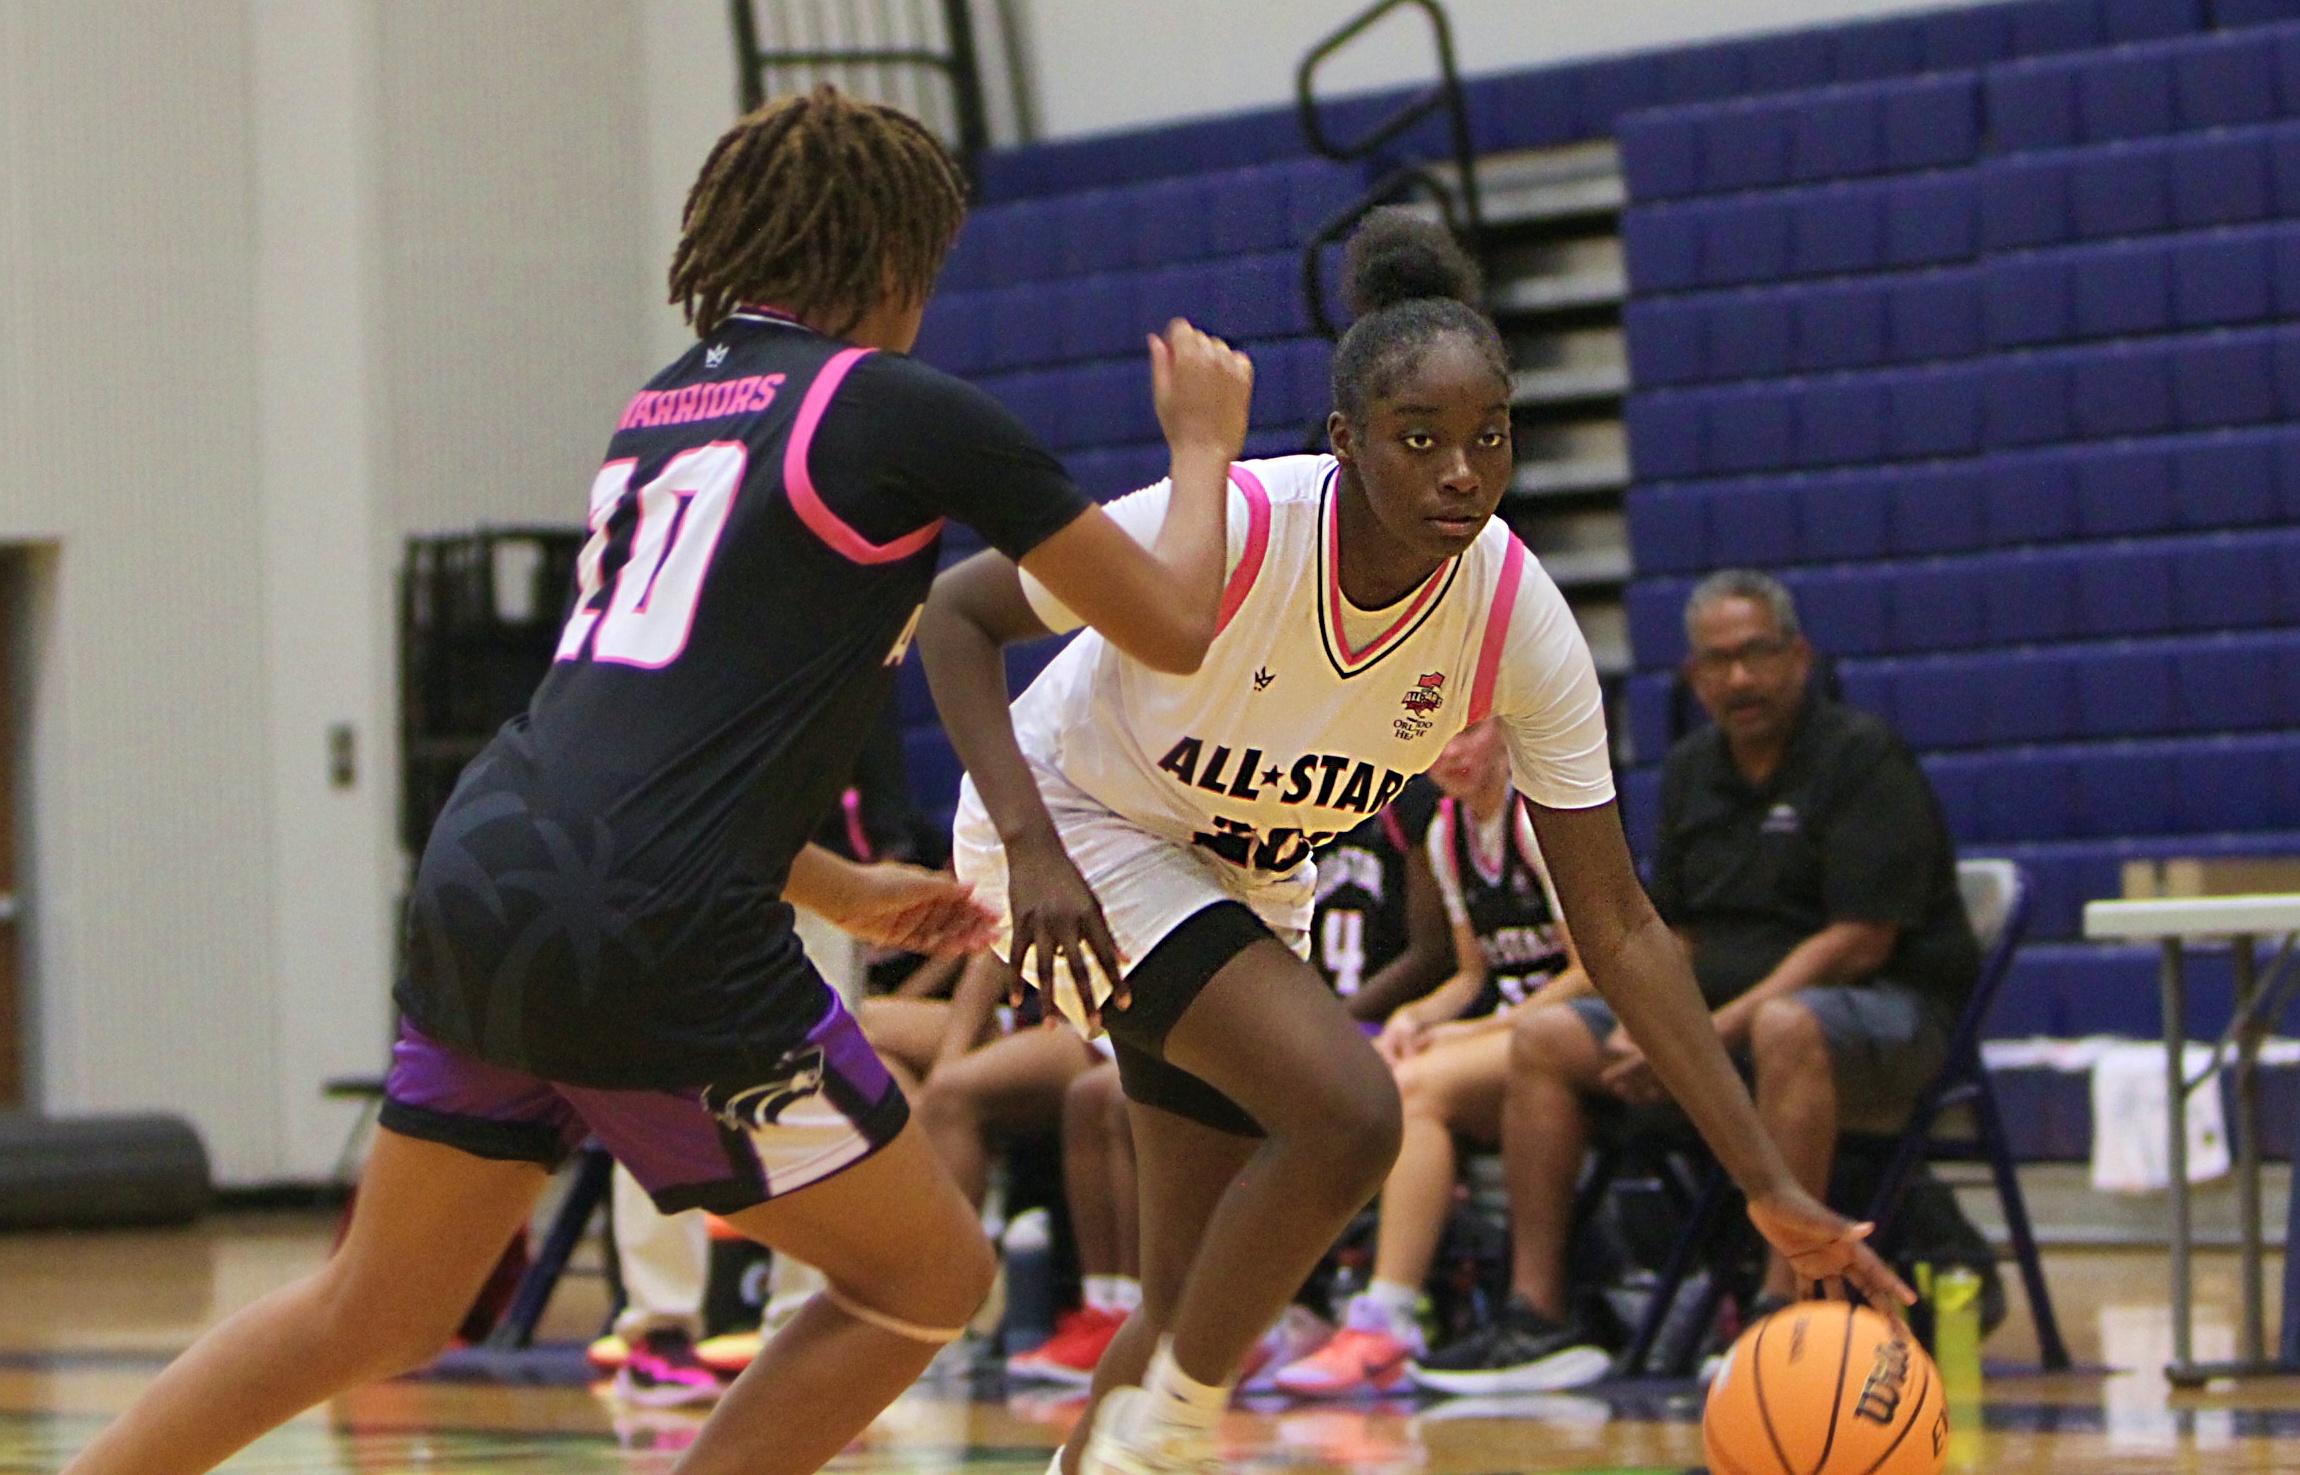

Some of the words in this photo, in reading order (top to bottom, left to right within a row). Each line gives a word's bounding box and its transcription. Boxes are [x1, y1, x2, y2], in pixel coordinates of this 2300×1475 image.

[554, 440, 748, 670] 10
[1393, 719, 1433, 733] ORLDO
[1157, 737, 1262, 801] ALL
[1323, 910, 1365, 994] 4
